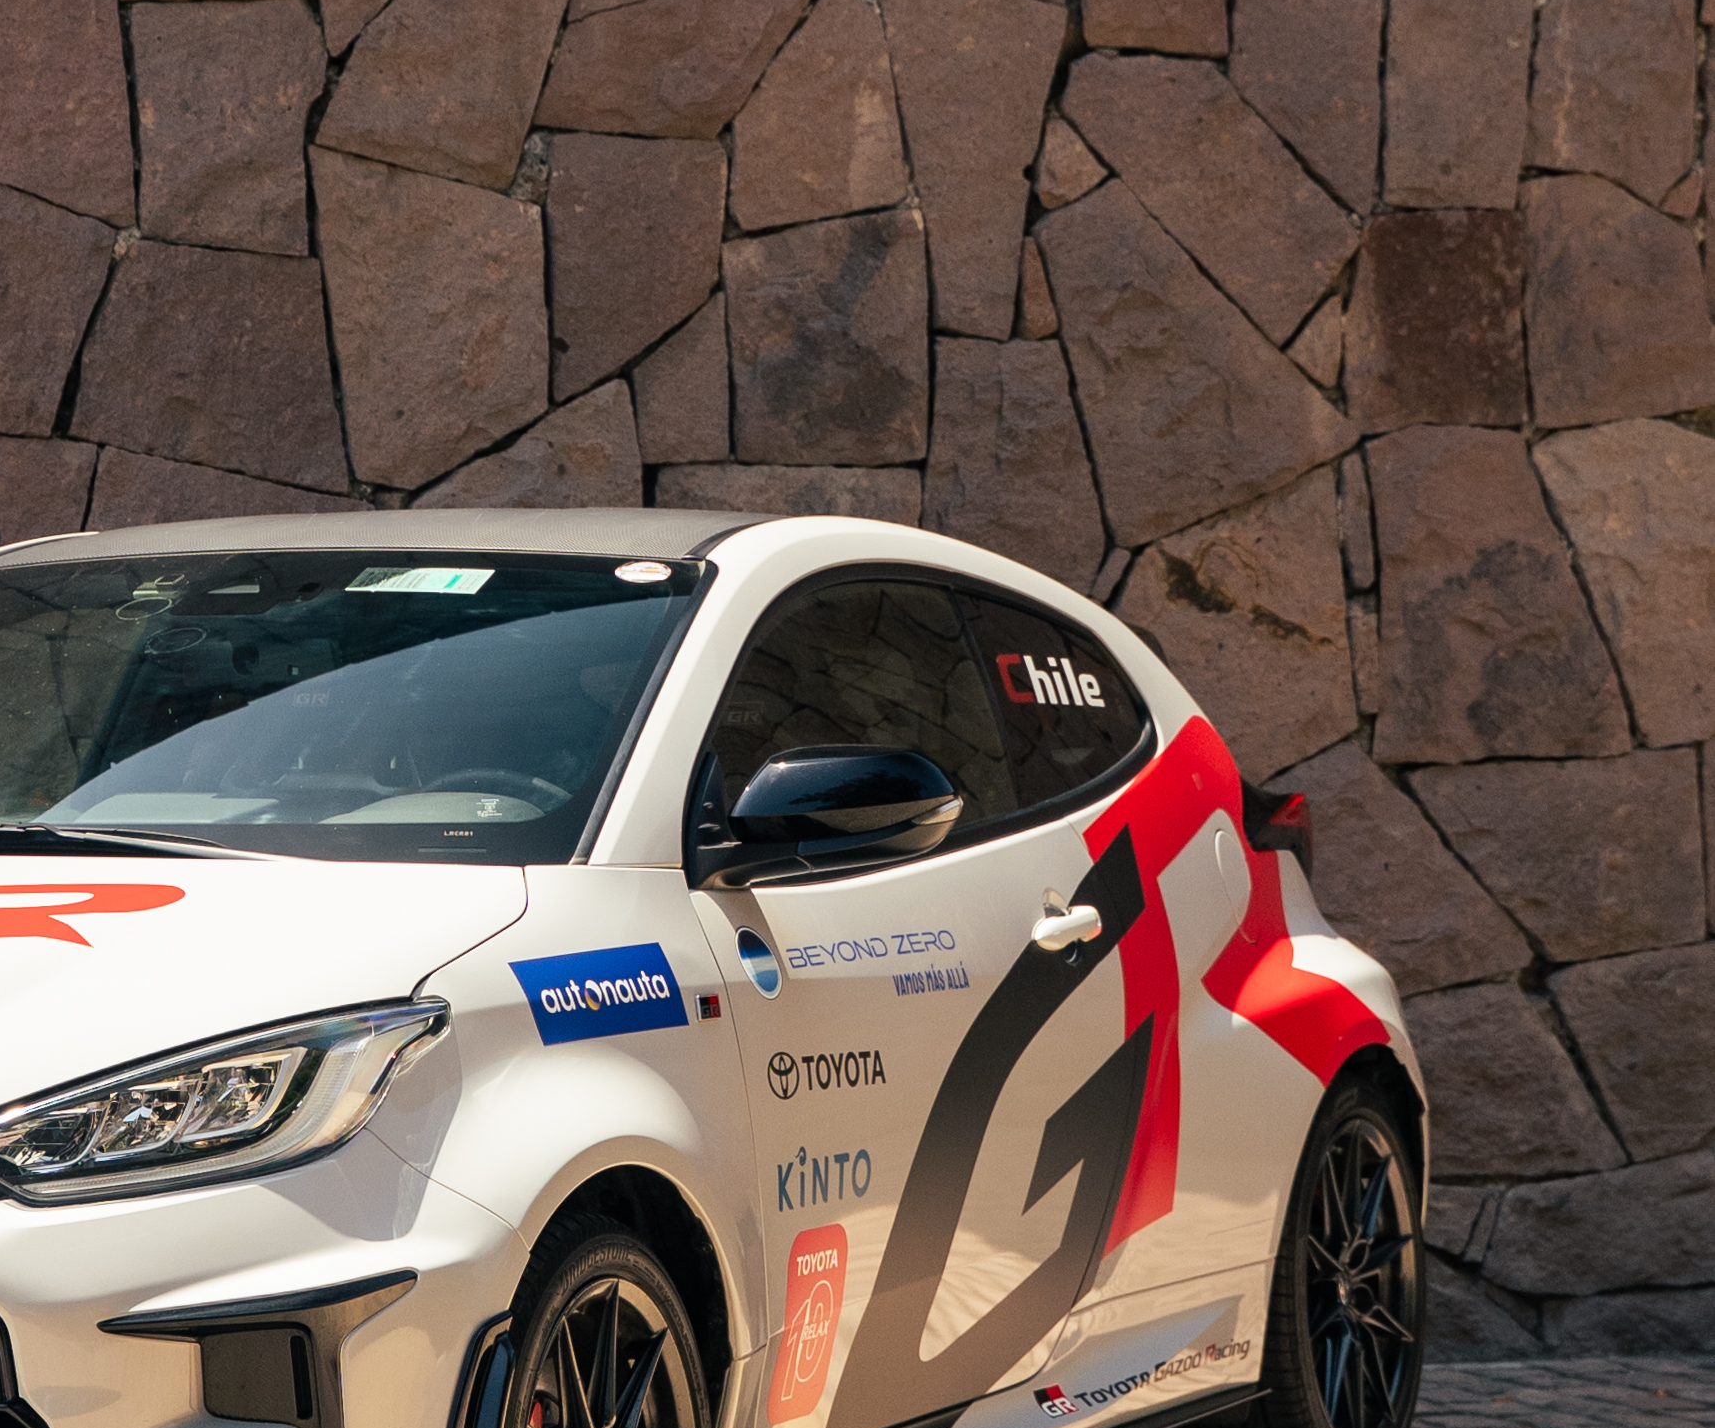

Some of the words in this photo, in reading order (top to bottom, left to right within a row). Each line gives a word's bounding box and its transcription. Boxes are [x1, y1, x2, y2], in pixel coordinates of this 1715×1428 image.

[996, 653, 1106, 708] Chile
[786, 937, 888, 969] BEYOND
[890, 930, 956, 955] ZERO
[540, 970, 671, 1014] autonauta
[892, 971, 925, 997] VAMOS
[924, 963, 946, 993] MÁS
[947, 960, 970, 990] ALLÁ
[801, 1050, 886, 1091] TOYOTA
[796, 1248, 839, 1277] TOYOTA
[801, 1319, 831, 1342] RELAX
[1041, 1397, 1076, 1418] GR
[1074, 1371, 1151, 1408] TOYOTA
[1154, 1353, 1202, 1383] GAZOO
[1205, 1338, 1251, 1365] Racing
